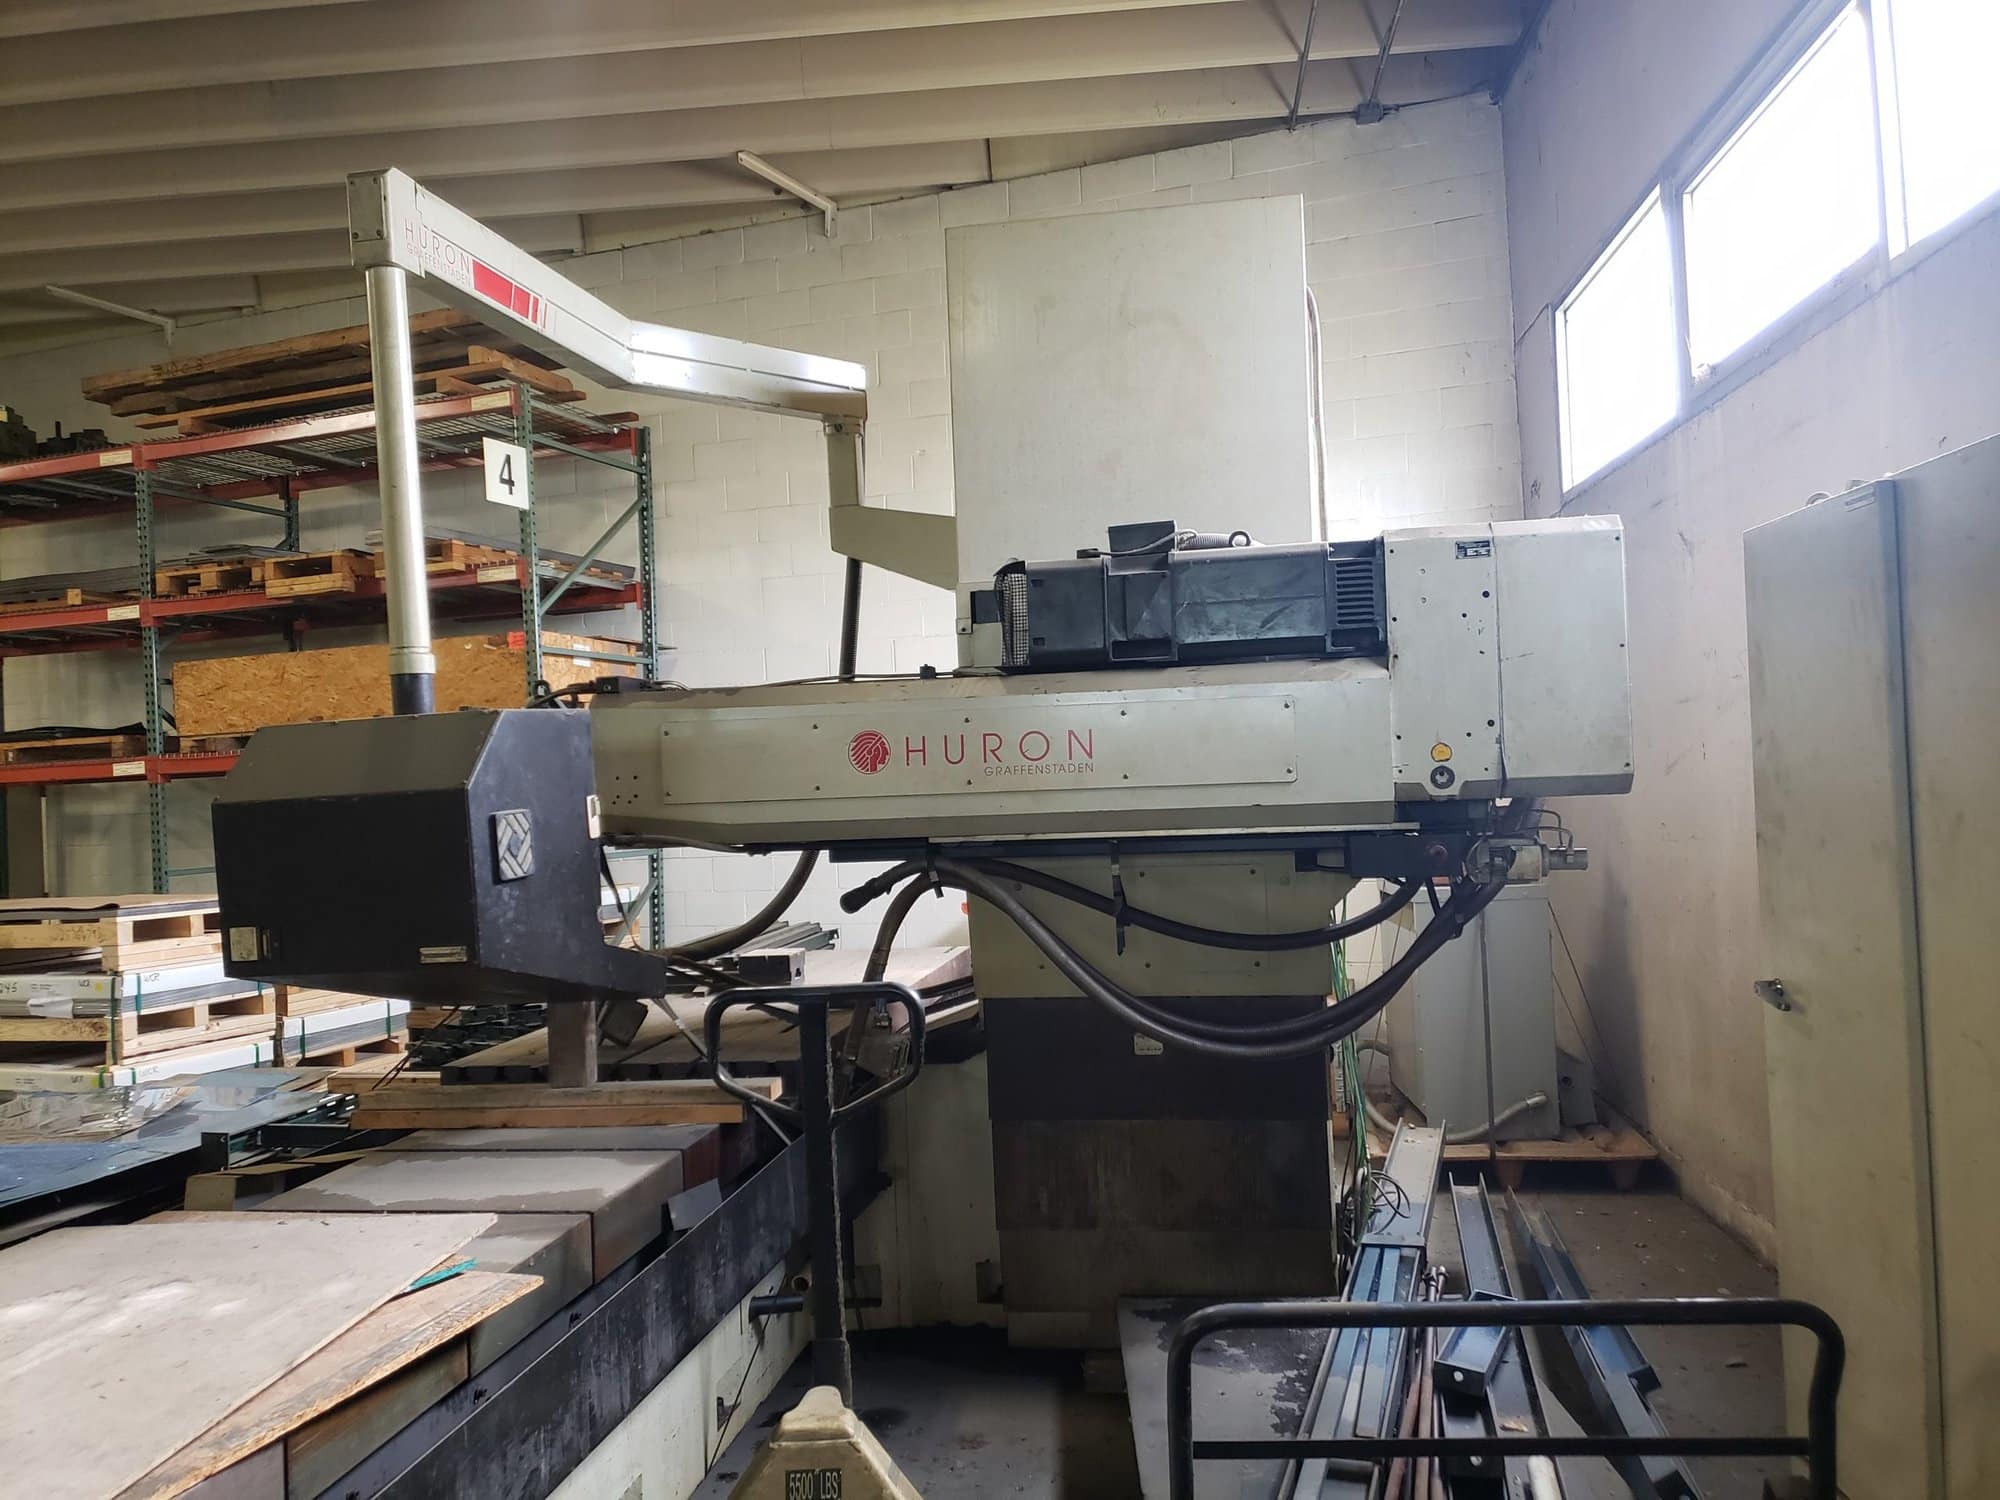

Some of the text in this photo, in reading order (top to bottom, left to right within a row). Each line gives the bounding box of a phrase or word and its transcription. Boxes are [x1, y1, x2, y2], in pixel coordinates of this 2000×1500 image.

[404, 217, 470, 274] HURON
[499, 454, 515, 495] 4
[905, 728, 1094, 767] HURON
[983, 761, 1095, 777] GRAFFENSTADEN
[789, 1471, 839, 1500] 5500 LBS
